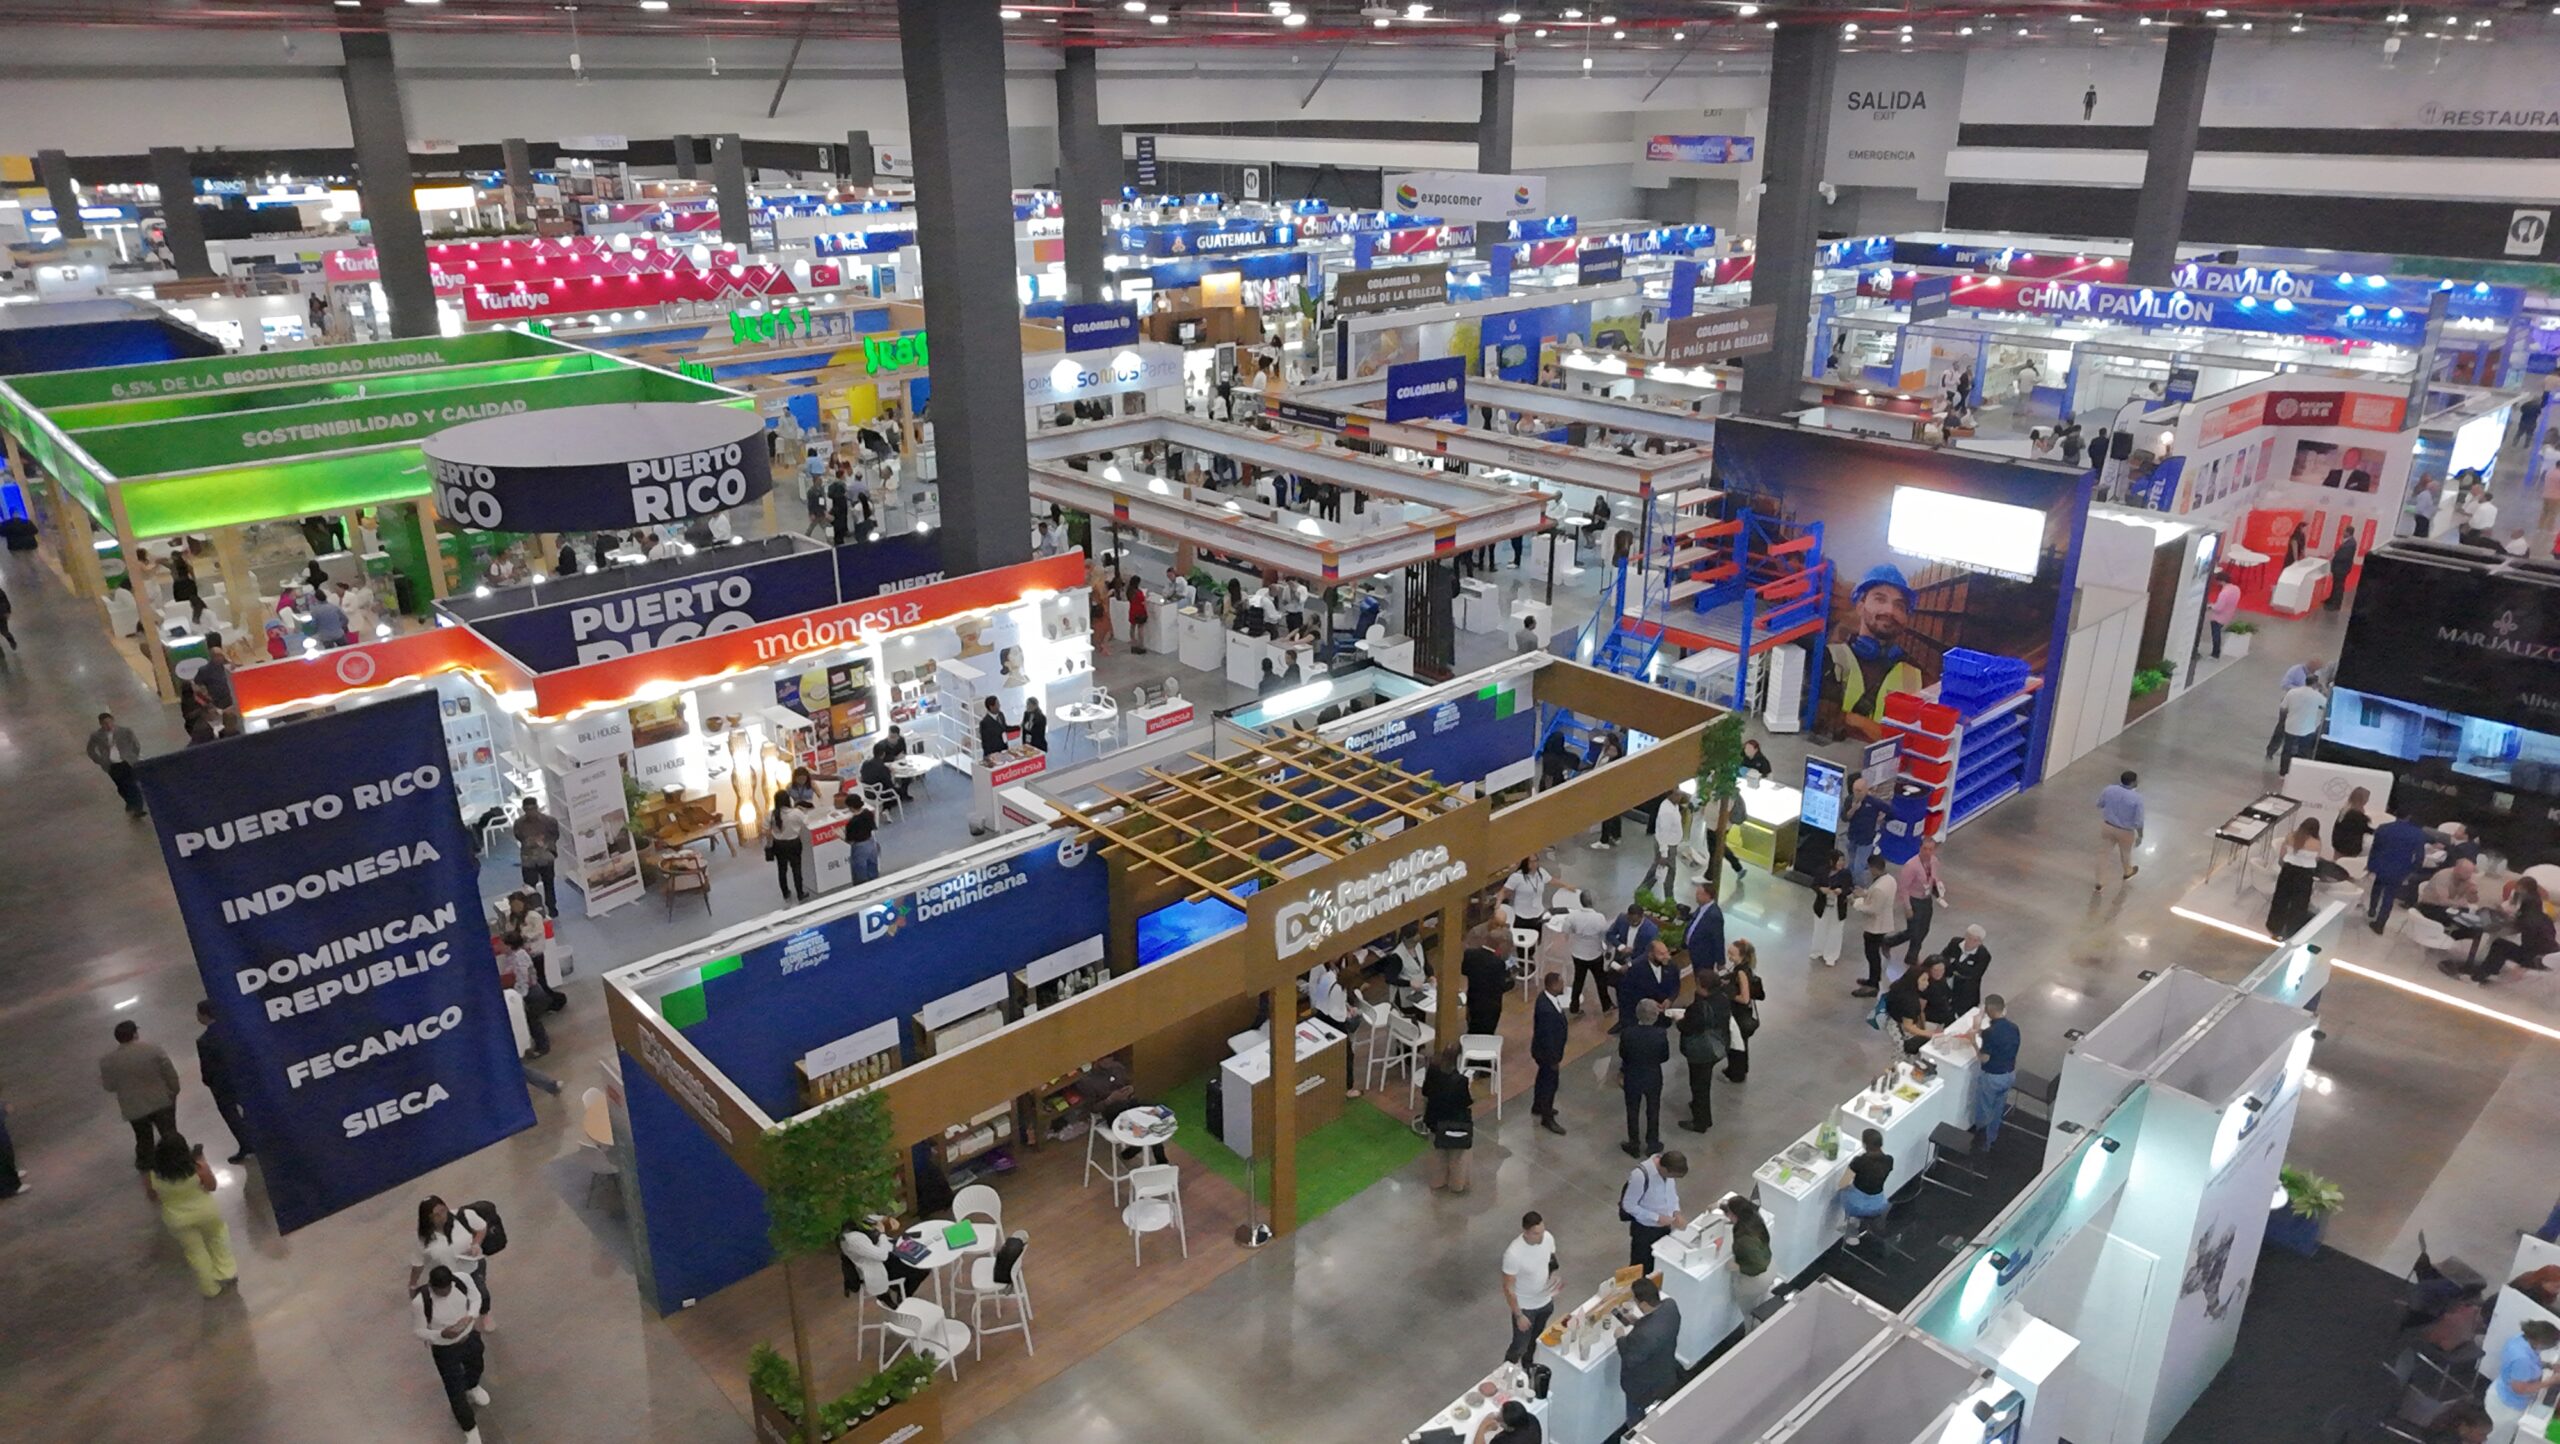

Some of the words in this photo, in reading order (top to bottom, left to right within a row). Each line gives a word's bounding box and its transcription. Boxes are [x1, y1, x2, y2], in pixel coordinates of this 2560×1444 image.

[1847, 90, 1926, 110] SALIDA
[1873, 111, 1896, 121] EXIT
[2442, 110, 2560, 126] RESTAURA
[1849, 151, 1915, 160] EMERGENCIA
[1421, 191, 1482, 207] expocomer
[1197, 231, 1266, 250] GUATEMALA
[1303, 219, 1337, 236] CHINA
[1341, 215, 1389, 233] PAVILION
[1436, 230, 1472, 248] CHINA
[1367, 275, 1411, 289] COLOMBIA
[1379, 292, 1391, 303] DE
[1393, 290, 1405, 301] LA
[2205, 273, 2314, 299] PAVILION
[480, 289, 549, 310] Türkiye
[2018, 286, 2091, 311] CHINA
[2098, 293, 2214, 323] PAVILION
[1072, 319, 1119, 333] COLOMBIA
[1696, 321, 1739, 338] COLOMBIA
[1671, 348, 1680, 360] EL
[1707, 342, 1718, 352] DE
[1720, 341, 1731, 350] LA
[1734, 333, 1768, 348] BELLEZA
[162, 377, 188, 391] DE
[193, 374, 219, 388] LA
[223, 359, 364, 386] BIODIVERSIDAD
[368, 351, 445, 370] MUNDIAL
[1396, 381, 1446, 400] COLOMBIA
[241, 411, 418, 448] SOSTENIBILIDAD
[422, 410, 436, 424] Y
[441, 399, 527, 423] CALIDAD
[627, 443, 742, 486] PUERTO
[437, 483, 503, 528] ICO
[631, 468, 747, 524] RICO
[571, 575, 752, 641] PUERTO
[753, 602, 923, 660] indonesia
[1150, 711, 1191, 730] indonesia
[994, 760, 1043, 782] indonesia
[175, 794, 344, 859] PUERTO
[352, 765, 441, 811] RICO
[221, 840, 441, 923] INDONESIA
[915, 860, 1011, 905] República
[1338, 844, 1450, 906] República
[917, 870, 1028, 923] Dominicana
[1338, 860, 1468, 933] Dominicana
[235, 902, 458, 996] DOMINICAN
[265, 942, 451, 1022] REPUBLIC
[286, 1005, 463, 1089] FECAMCO
[342, 1083, 450, 1138] SIECA
